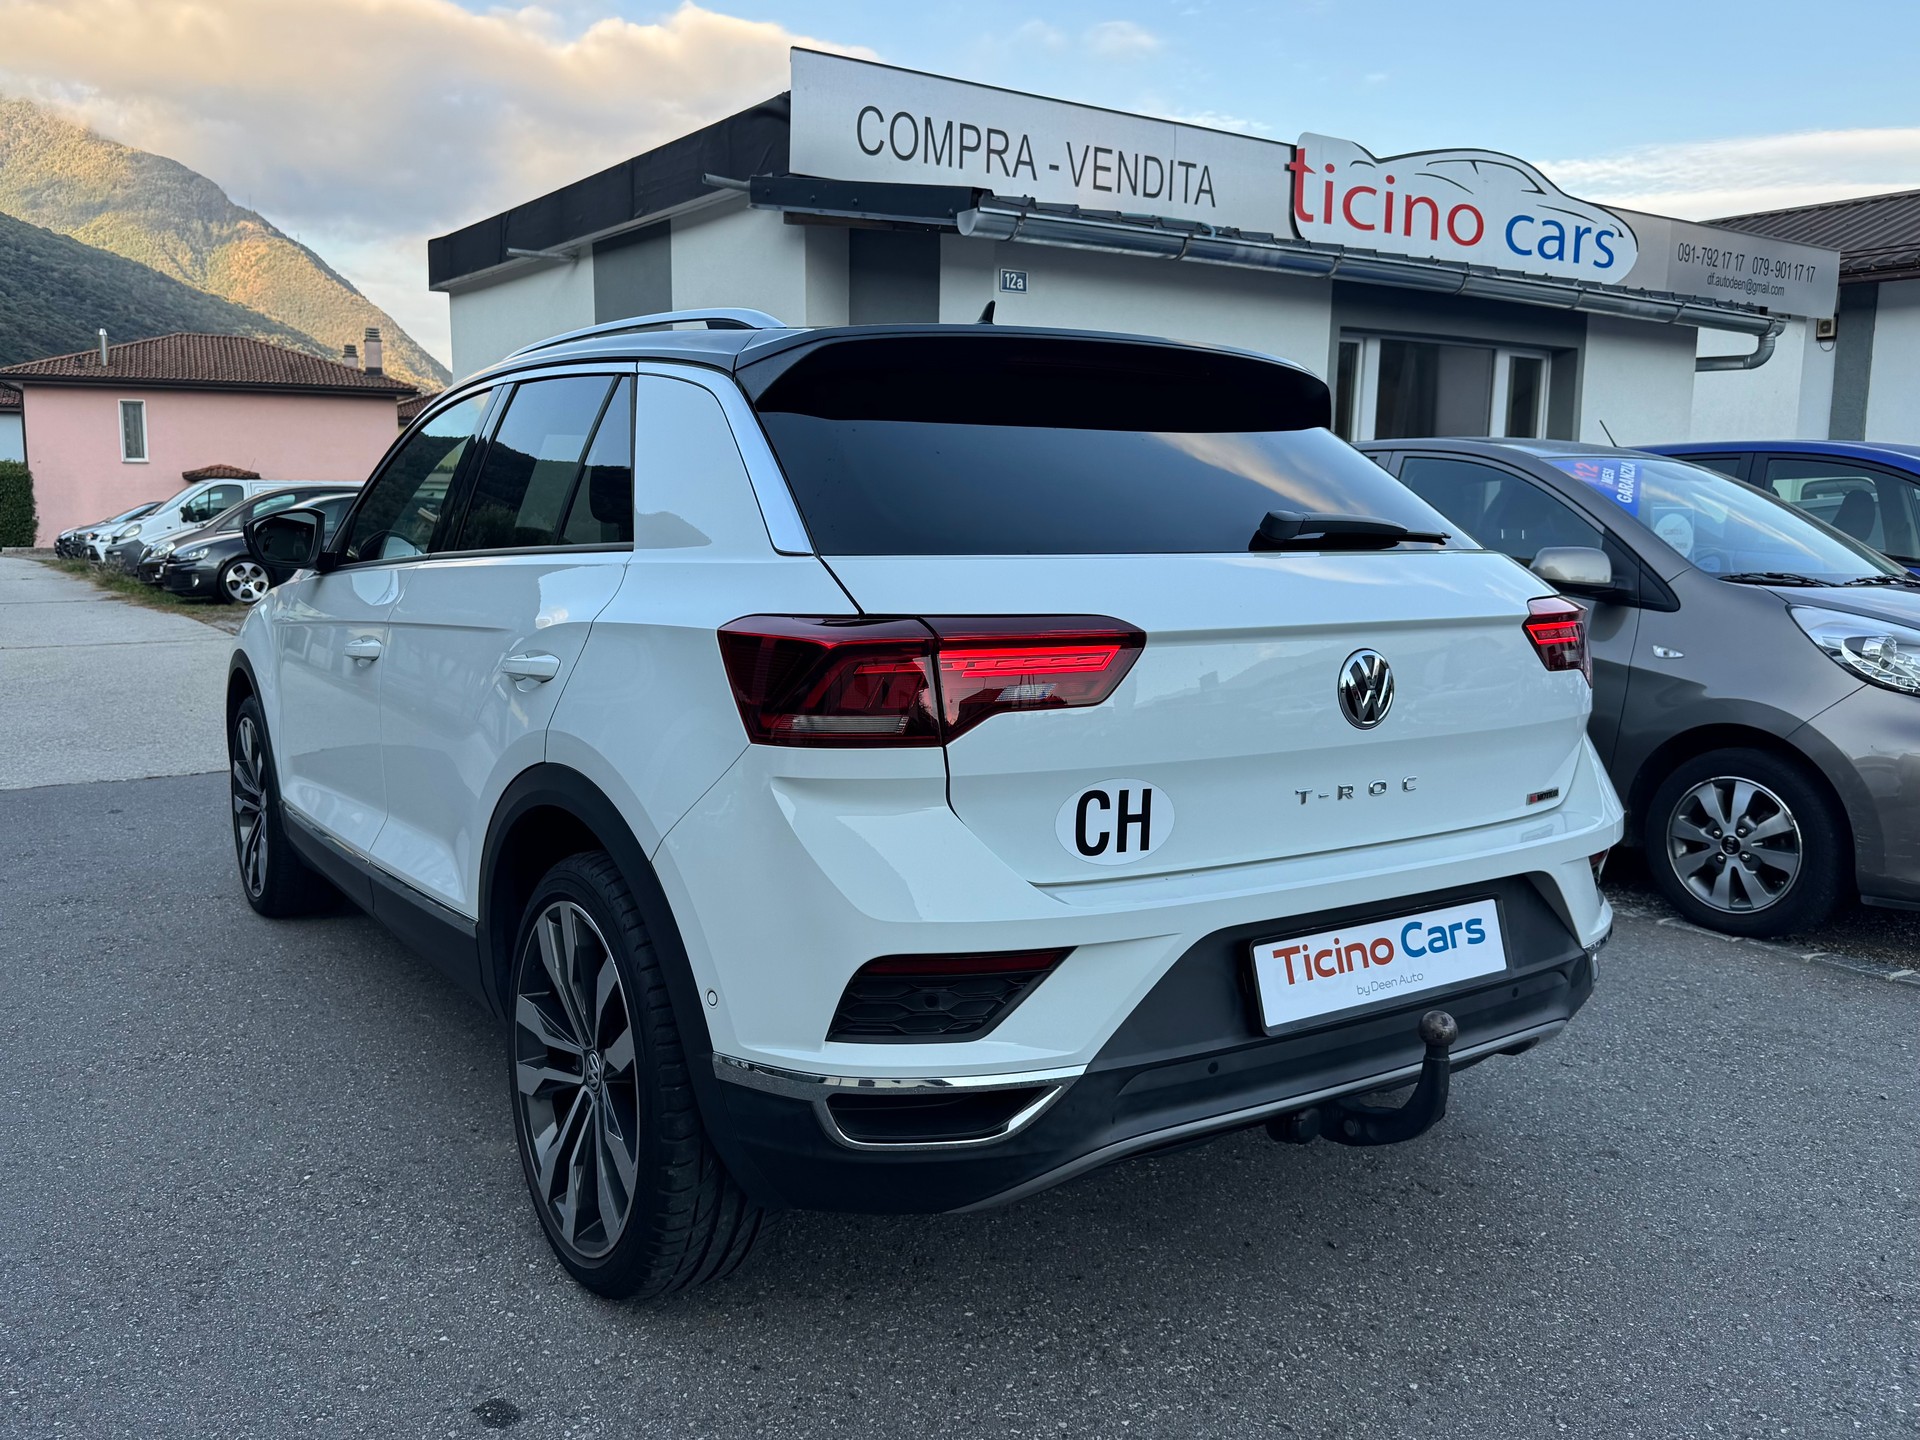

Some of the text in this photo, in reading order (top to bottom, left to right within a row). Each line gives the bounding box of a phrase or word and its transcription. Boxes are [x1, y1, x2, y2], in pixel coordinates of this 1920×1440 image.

[856, 105, 1038, 181] COMPRA
[1066, 141, 1216, 208] VENDITA
[1289, 148, 1615, 269] ticino cars
[1677, 242, 1719, 268] 091-792
[1004, 272, 1024, 290] 12a
[1574, 462, 1599, 478] 12
[1616, 461, 1636, 504] GARANZIA
[1074, 788, 1153, 857] CH
[1272, 918, 1486, 986] Ticino Cars
[1356, 973, 1424, 996] by Deen Auto
